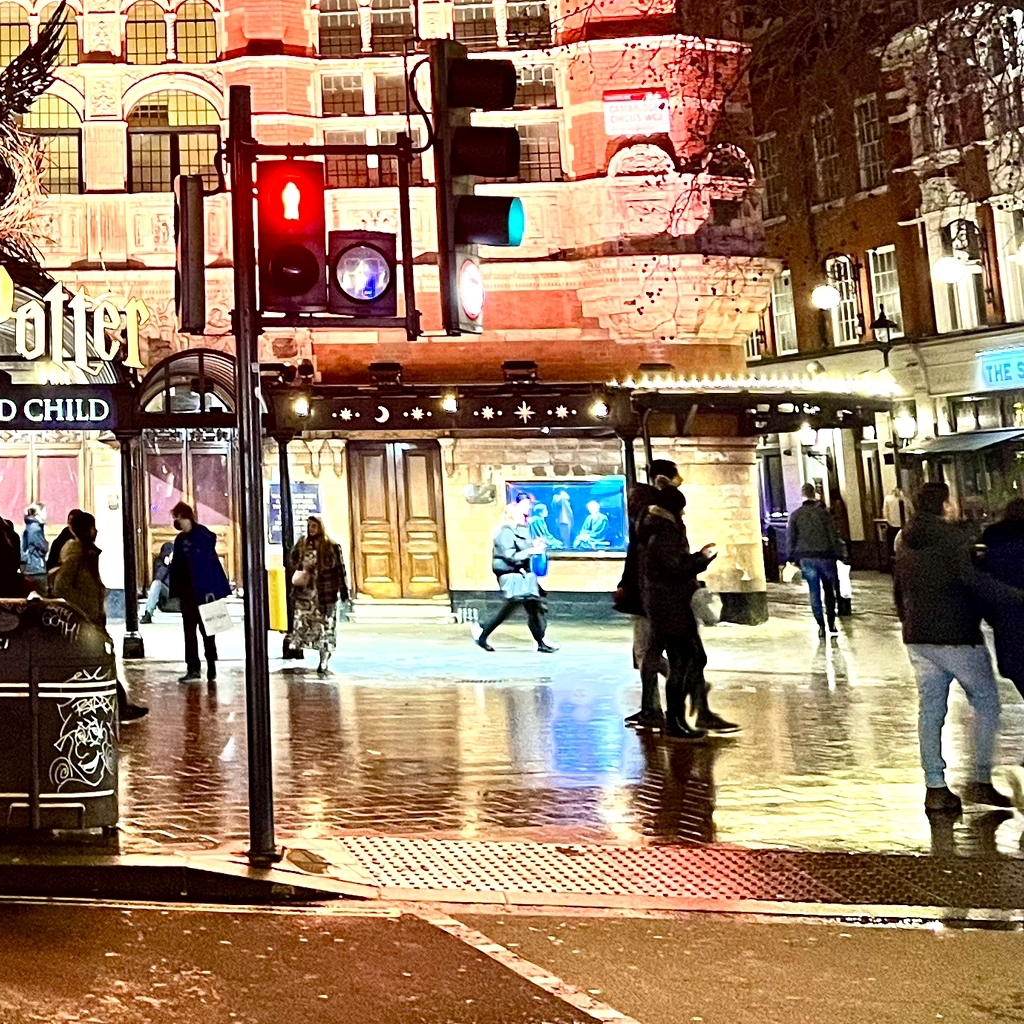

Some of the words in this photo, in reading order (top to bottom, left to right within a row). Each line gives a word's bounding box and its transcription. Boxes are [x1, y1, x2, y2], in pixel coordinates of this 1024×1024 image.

[610, 113, 642, 123] CIRCUS
[645, 112, 663, 122] WC2
[985, 363, 1013, 383] THE
[23, 398, 110, 422] CHILD
